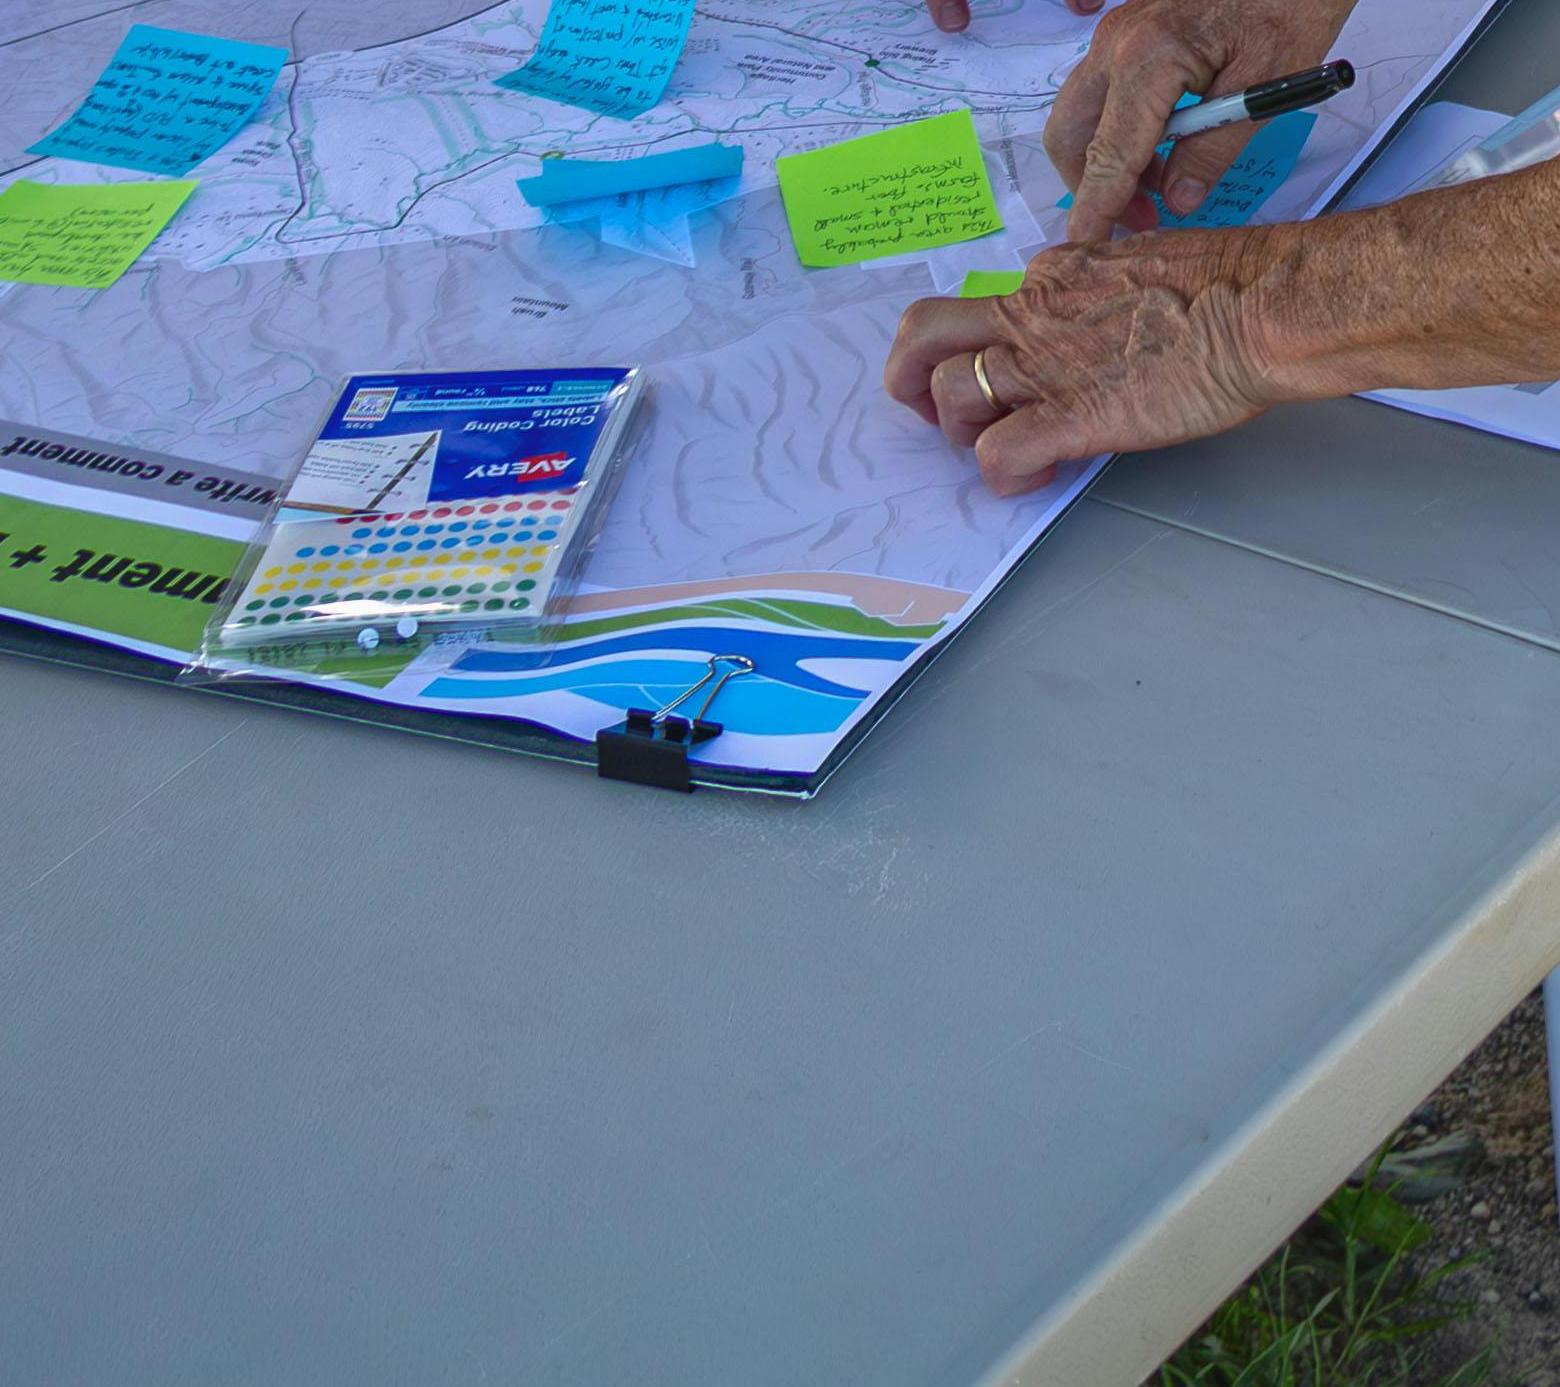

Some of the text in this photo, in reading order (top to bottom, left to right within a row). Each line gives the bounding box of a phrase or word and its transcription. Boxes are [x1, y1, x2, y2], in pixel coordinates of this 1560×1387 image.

[511, 294, 568, 312] Mountain
[531, 404, 601, 418] Labels
[464, 414, 596, 433] Color Coding
[0, 435, 166, 481] comment
[167, 467, 194, 486] a
[463, 457, 577, 480] AVERY
